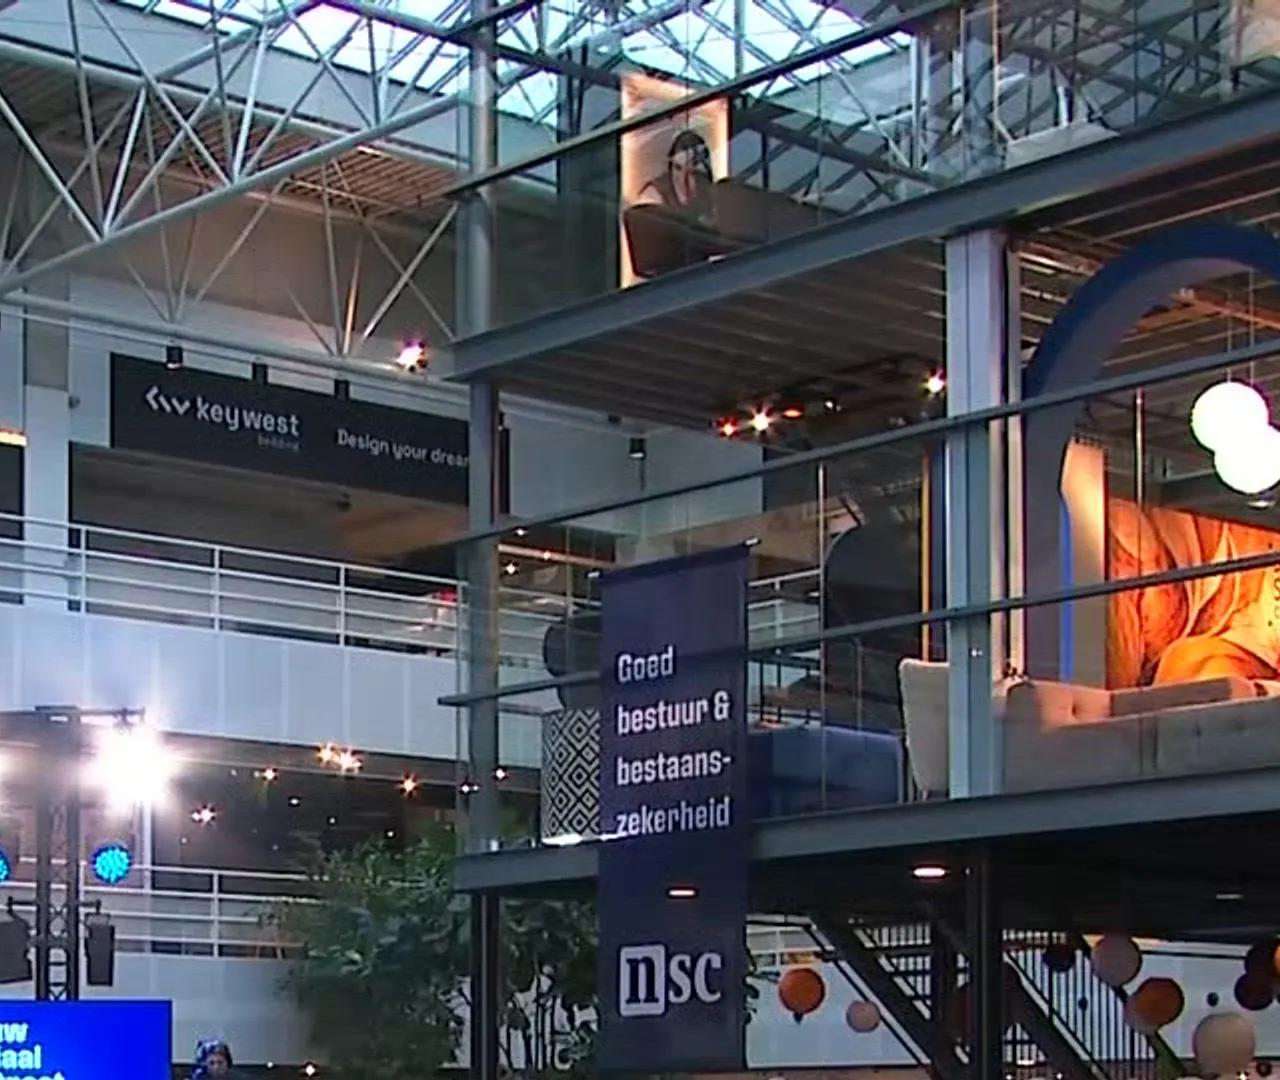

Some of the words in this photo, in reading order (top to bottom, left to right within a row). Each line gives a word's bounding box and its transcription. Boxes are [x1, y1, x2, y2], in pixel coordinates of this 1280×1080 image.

[336, 429, 389, 456] Design
[392, 440, 426, 460] your
[618, 646, 674, 682] Goed
[617, 699, 709, 735] bestuur
[714, 690, 731, 720] &
[617, 750, 731, 785] bestaans-
[616, 796, 731, 834] zekerheid
